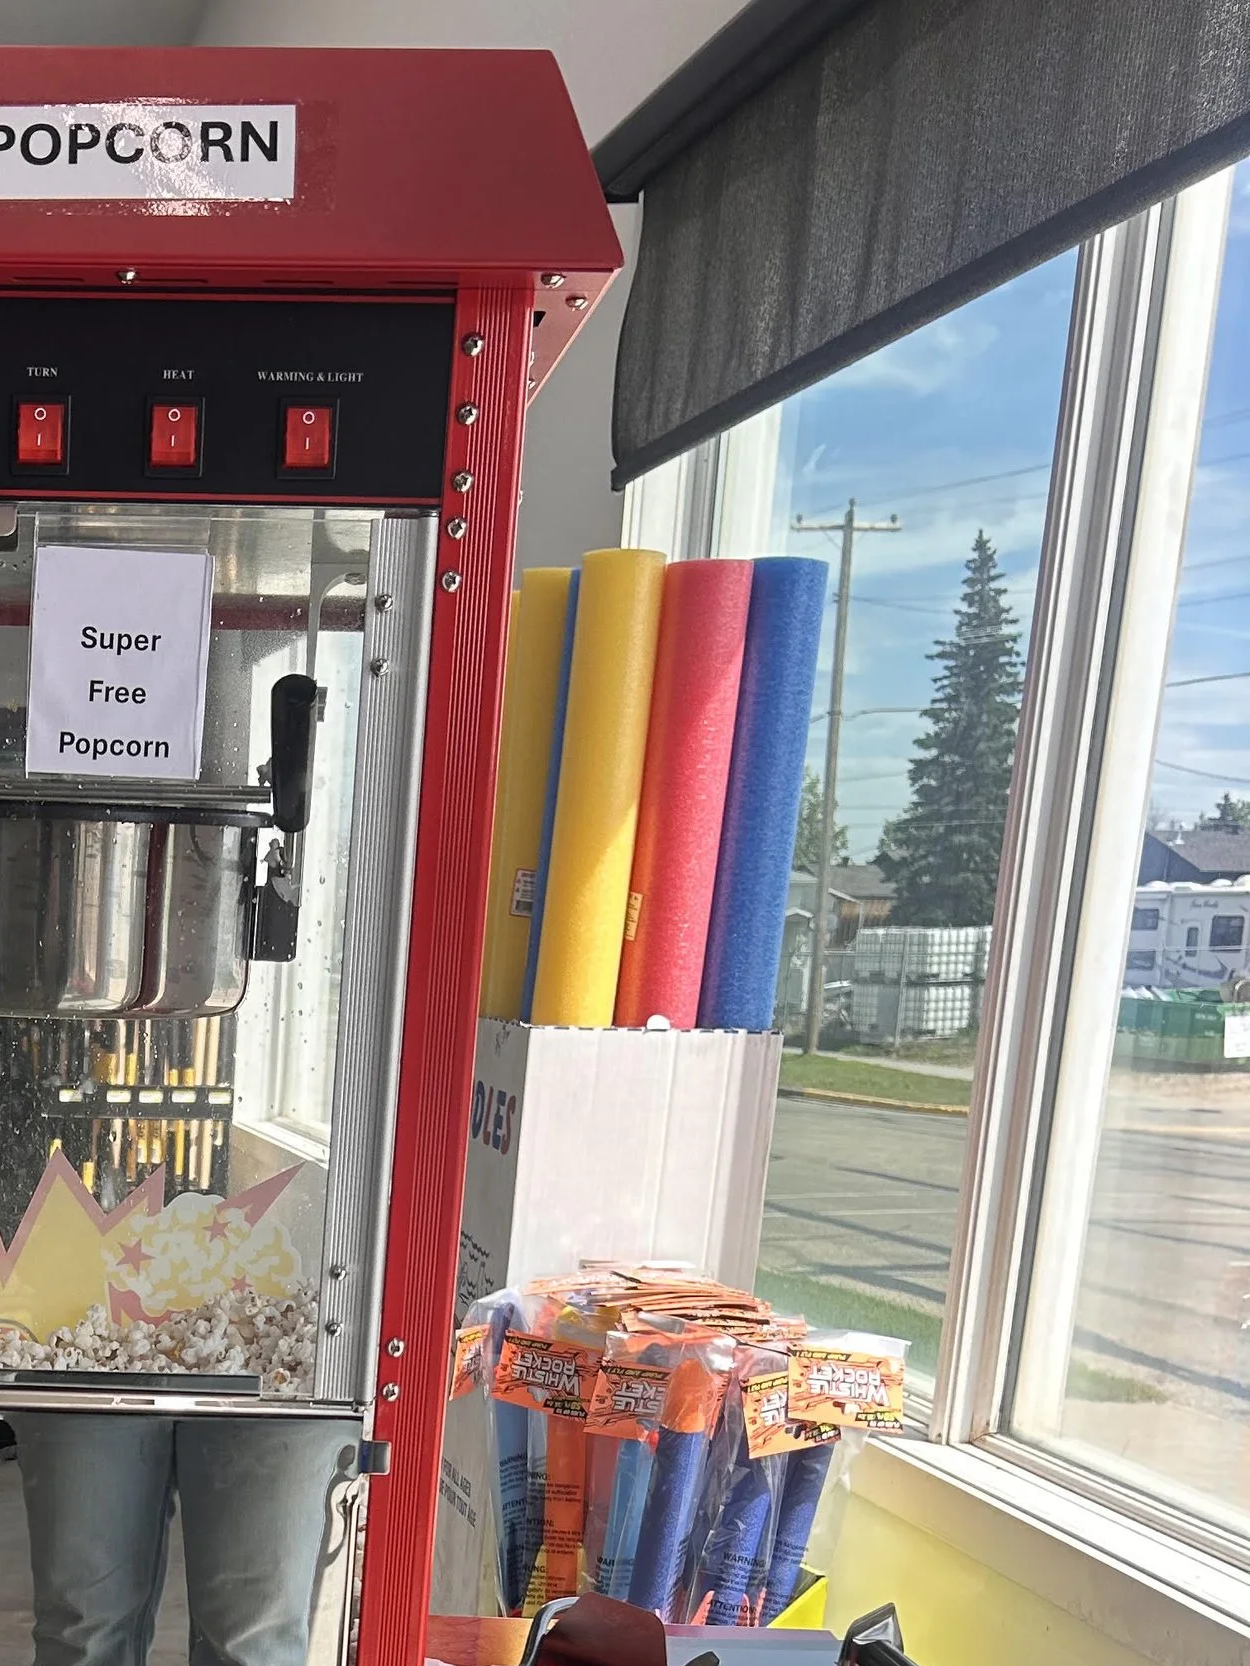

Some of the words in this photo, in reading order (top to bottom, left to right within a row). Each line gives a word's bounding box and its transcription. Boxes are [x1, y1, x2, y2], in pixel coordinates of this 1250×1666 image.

[27, 367, 58, 377] TURN
[163, 370, 194, 379] HEAT
[257, 371, 314, 382] WARMING
[316, 373, 325, 382] &
[327, 373, 364, 382] LIGHT
[81, 626, 161, 655] Super
[89, 680, 146, 704] Free
[59, 731, 169, 760] Popcorn
[472, 1081, 516, 1155] DLES
[515, 1351, 574, 1375] ROCKET
[808, 1363, 881, 1385] ROCKET
[511, 1365, 579, 1396] WHISTLE
[615, 1380, 667, 1401] CKET
[806, 1379, 890, 1406] WHISTLE
[611, 1396, 660, 1413] STLE
[502, 1498, 527, 1511] ATTENT
